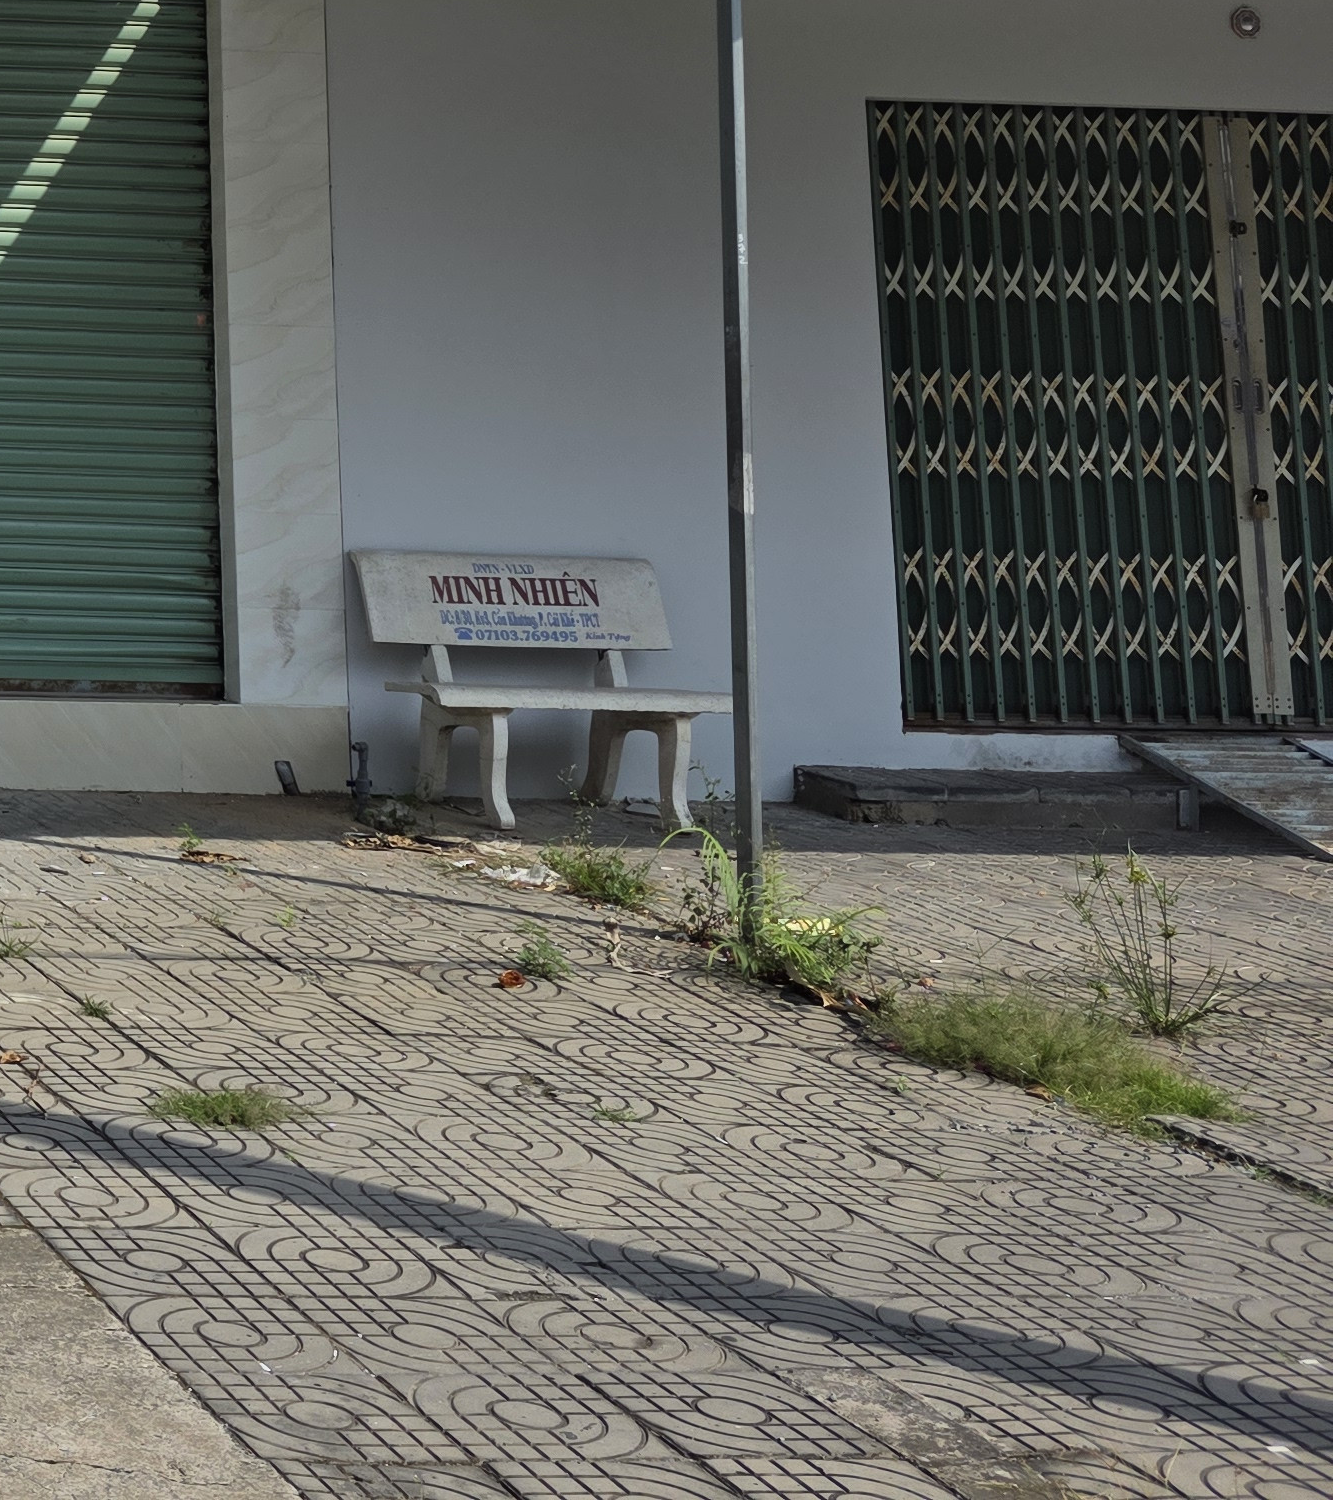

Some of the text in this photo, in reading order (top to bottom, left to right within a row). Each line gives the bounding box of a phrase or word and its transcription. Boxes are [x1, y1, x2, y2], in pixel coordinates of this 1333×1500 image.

[428, 571, 600, 607] MINH NHIÊN
[475, 629, 578, 643] 07103.769495
